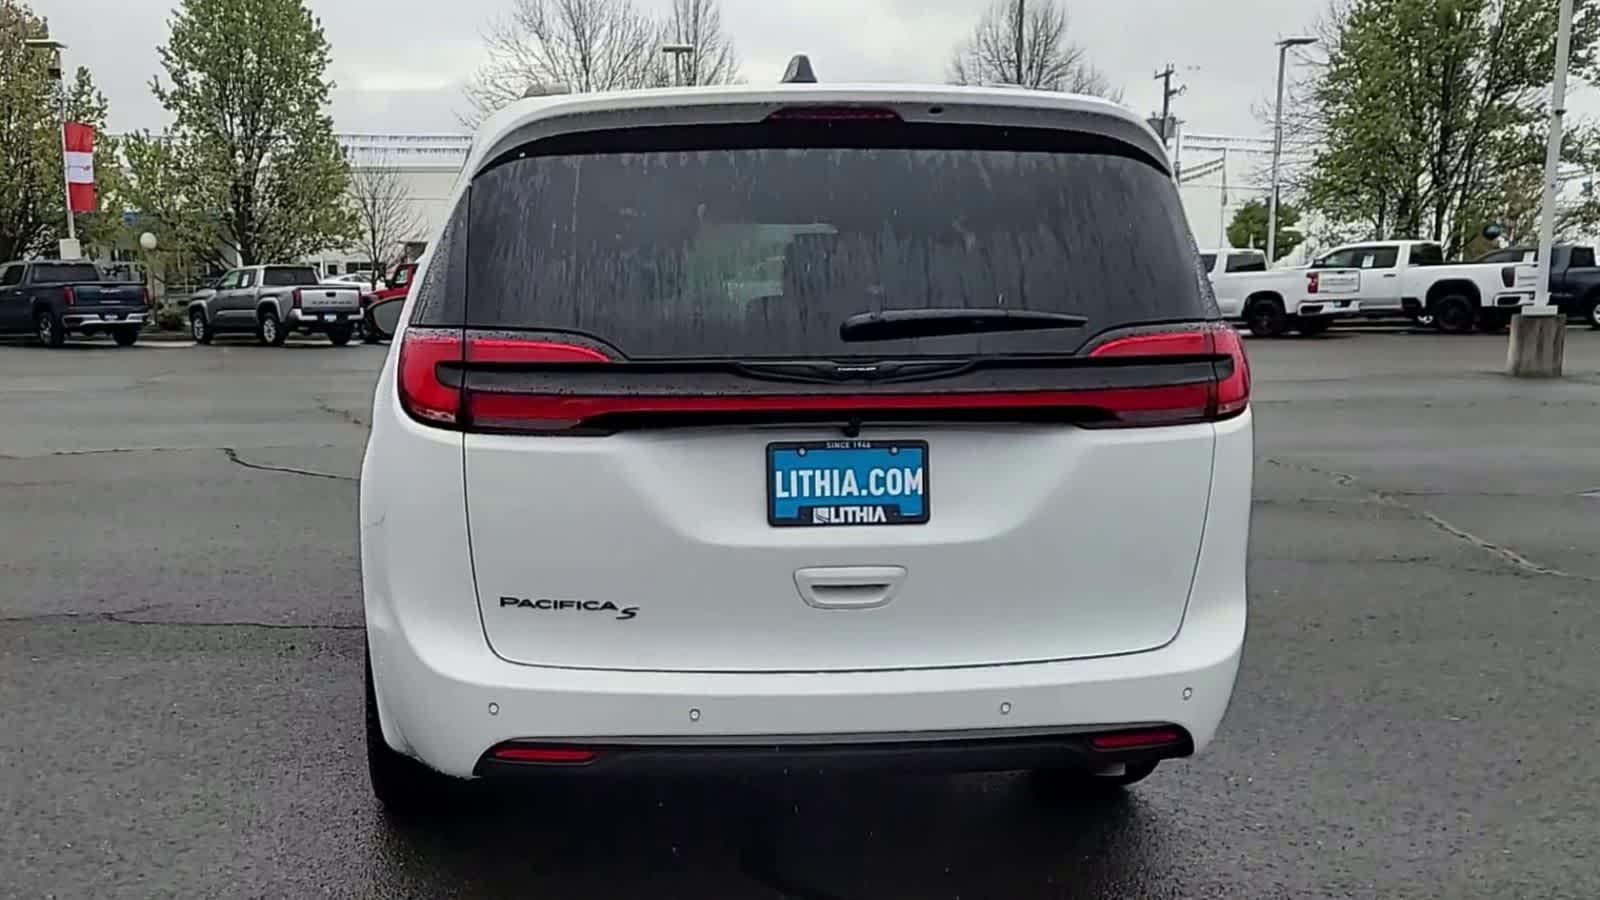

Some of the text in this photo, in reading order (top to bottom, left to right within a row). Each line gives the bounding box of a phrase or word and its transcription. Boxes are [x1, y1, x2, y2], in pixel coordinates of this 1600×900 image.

[826, 441, 850, 449] SINCE
[775, 467, 924, 498] LITHIA.COM
[830, 506, 887, 523] LITHIA
[499, 596, 640, 620] PACIFICA S
